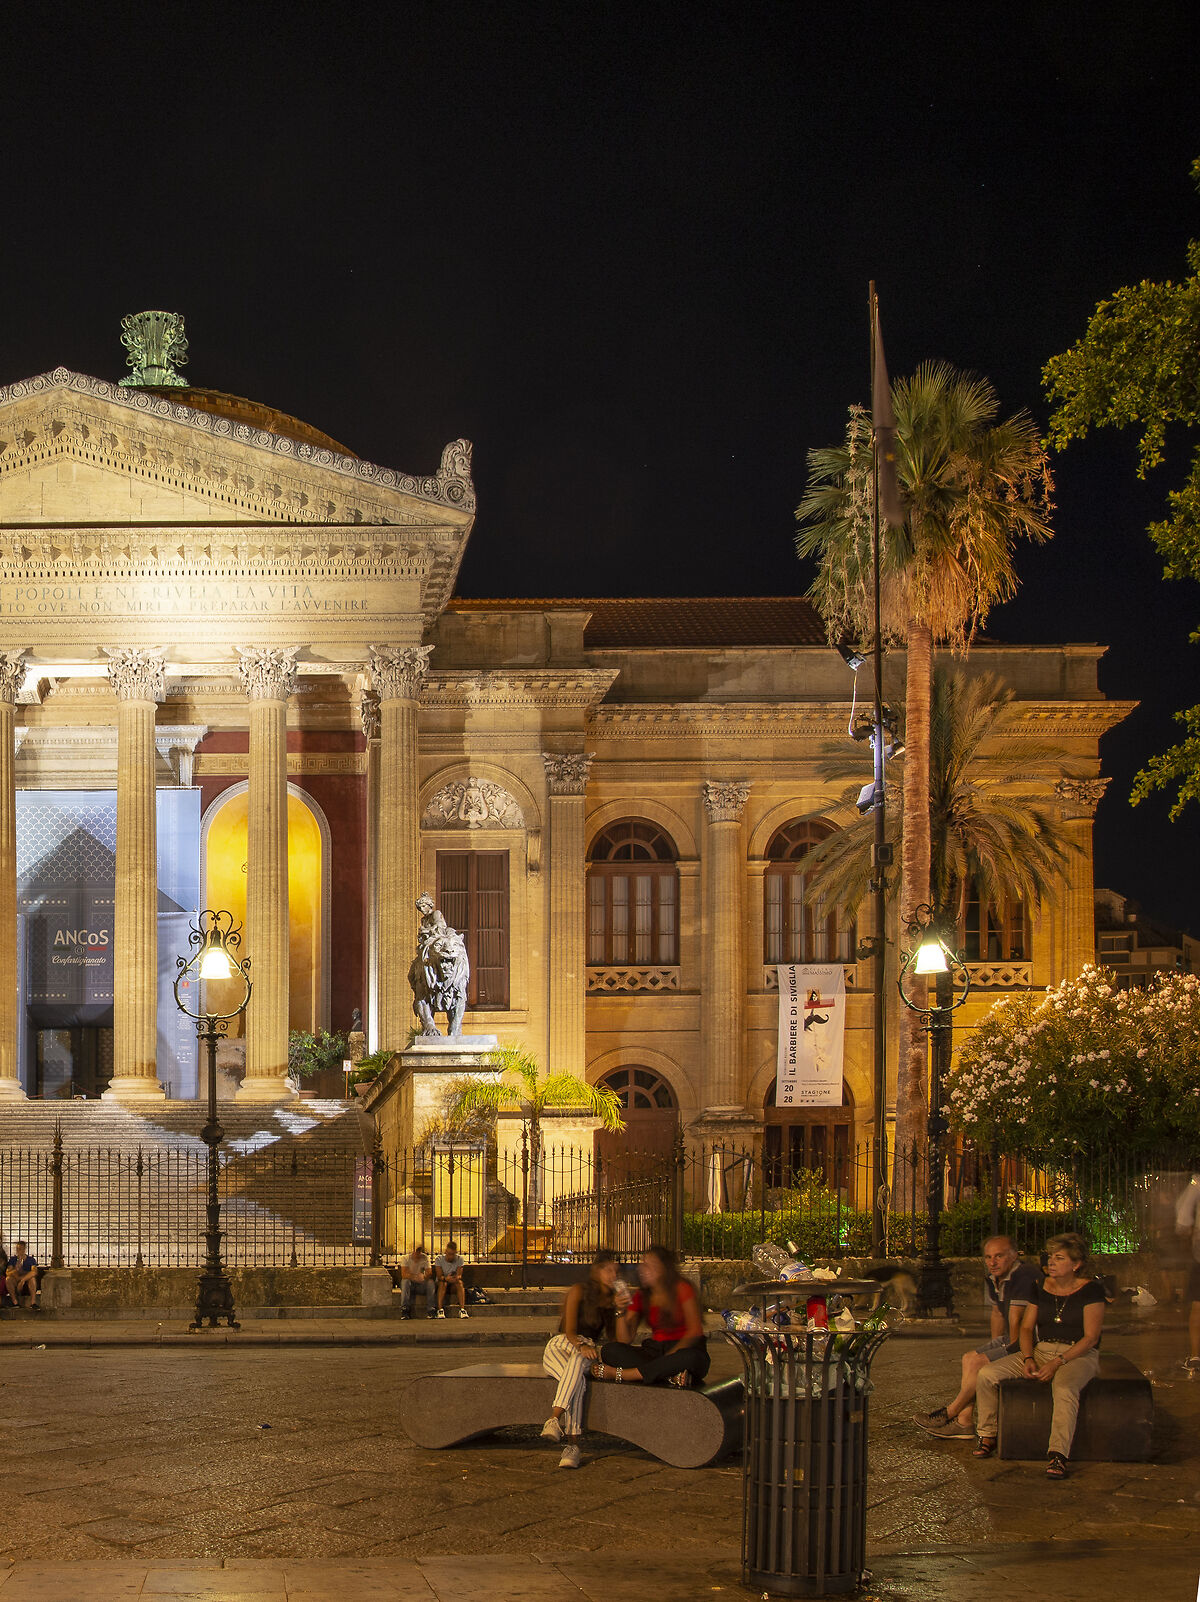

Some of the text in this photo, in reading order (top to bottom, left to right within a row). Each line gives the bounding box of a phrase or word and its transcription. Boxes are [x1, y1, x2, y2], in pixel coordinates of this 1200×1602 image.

[268, 585, 313, 598] VITA
[38, 603, 67, 613] OVE
[79, 602, 111, 612] NON
[190, 601, 269, 611] PREPARAR
[281, 600, 368, 611] L'AVVENIRE
[54, 930, 109, 945] ANCoS
[789, 965, 798, 1076] IL BARBIERE DI SIVIGLIA
